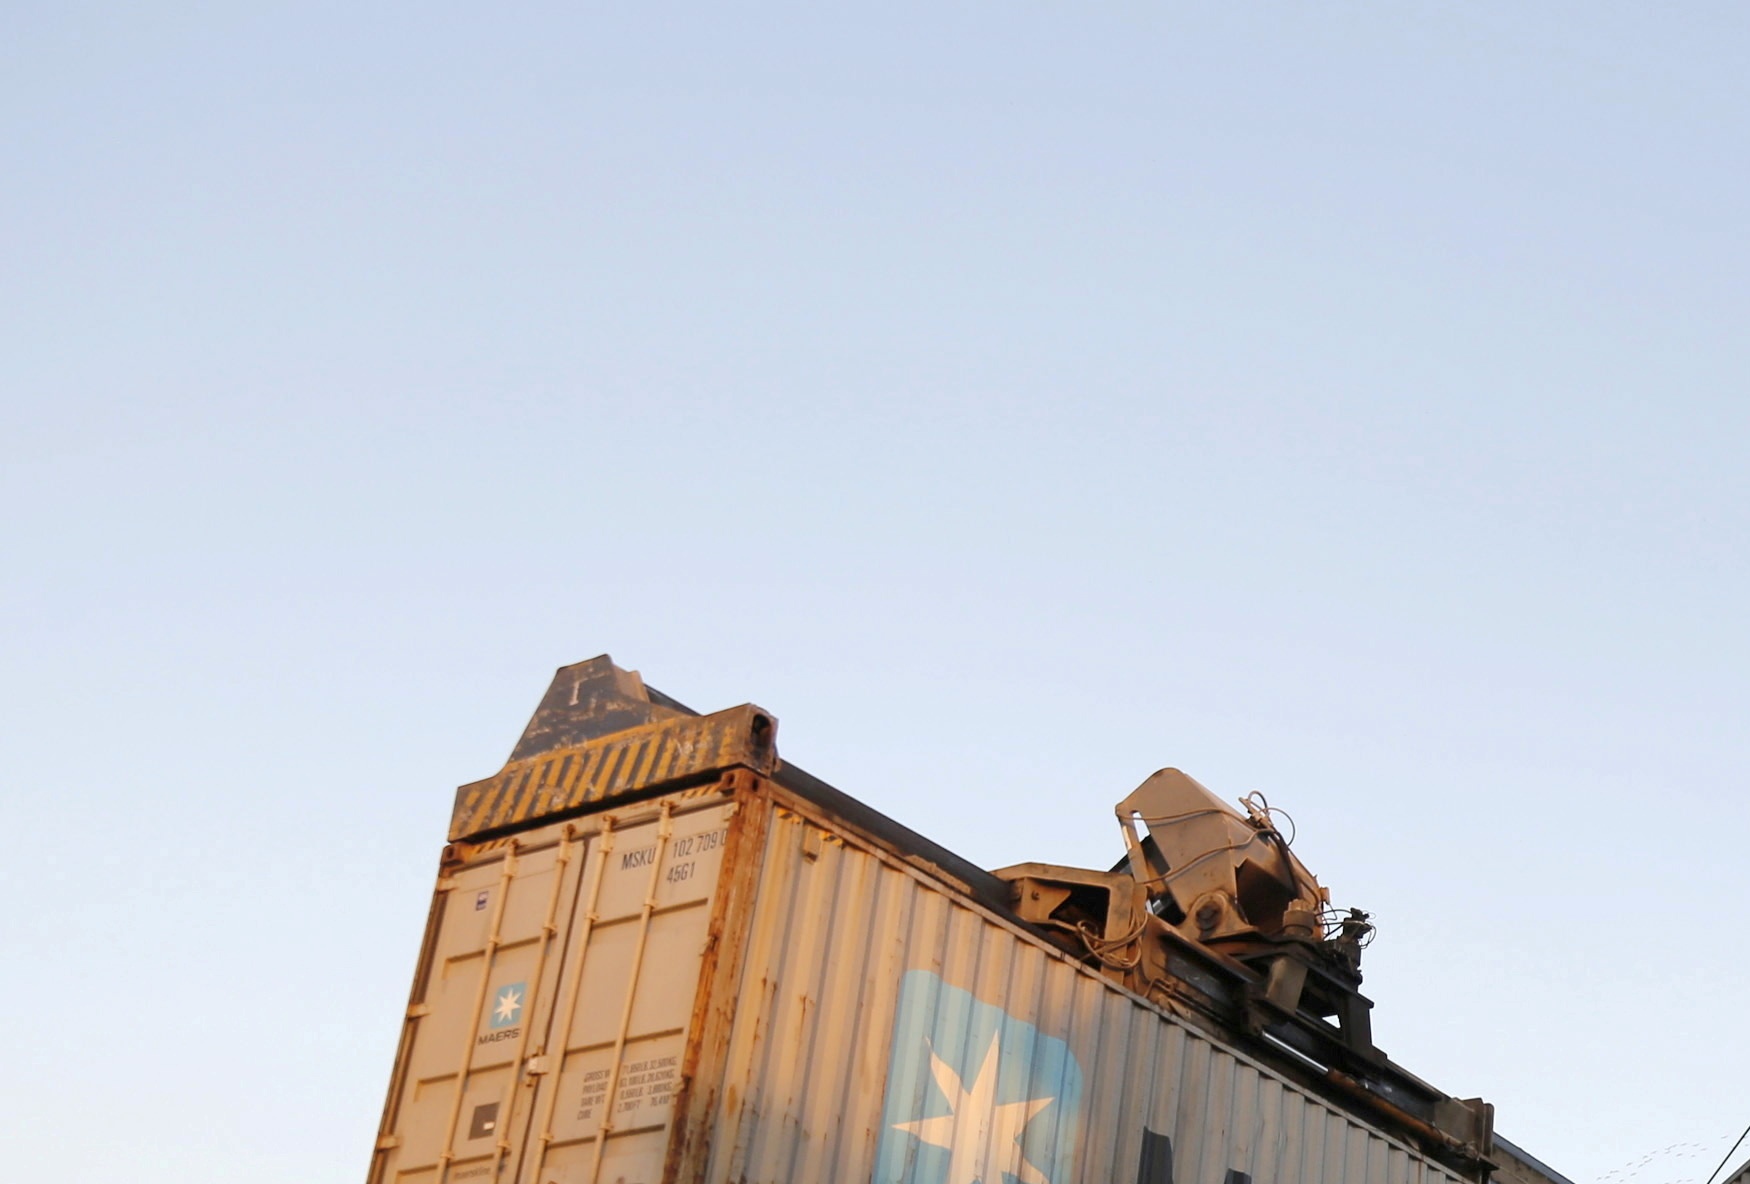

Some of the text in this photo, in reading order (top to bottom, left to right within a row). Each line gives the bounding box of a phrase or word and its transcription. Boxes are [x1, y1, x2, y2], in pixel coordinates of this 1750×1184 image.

[621, 848, 657, 871] MSKU
[673, 838, 693, 859] 102
[697, 831, 718, 853] 709
[667, 862, 696, 883] 45G1
[478, 1028, 521, 1046] MAERS
